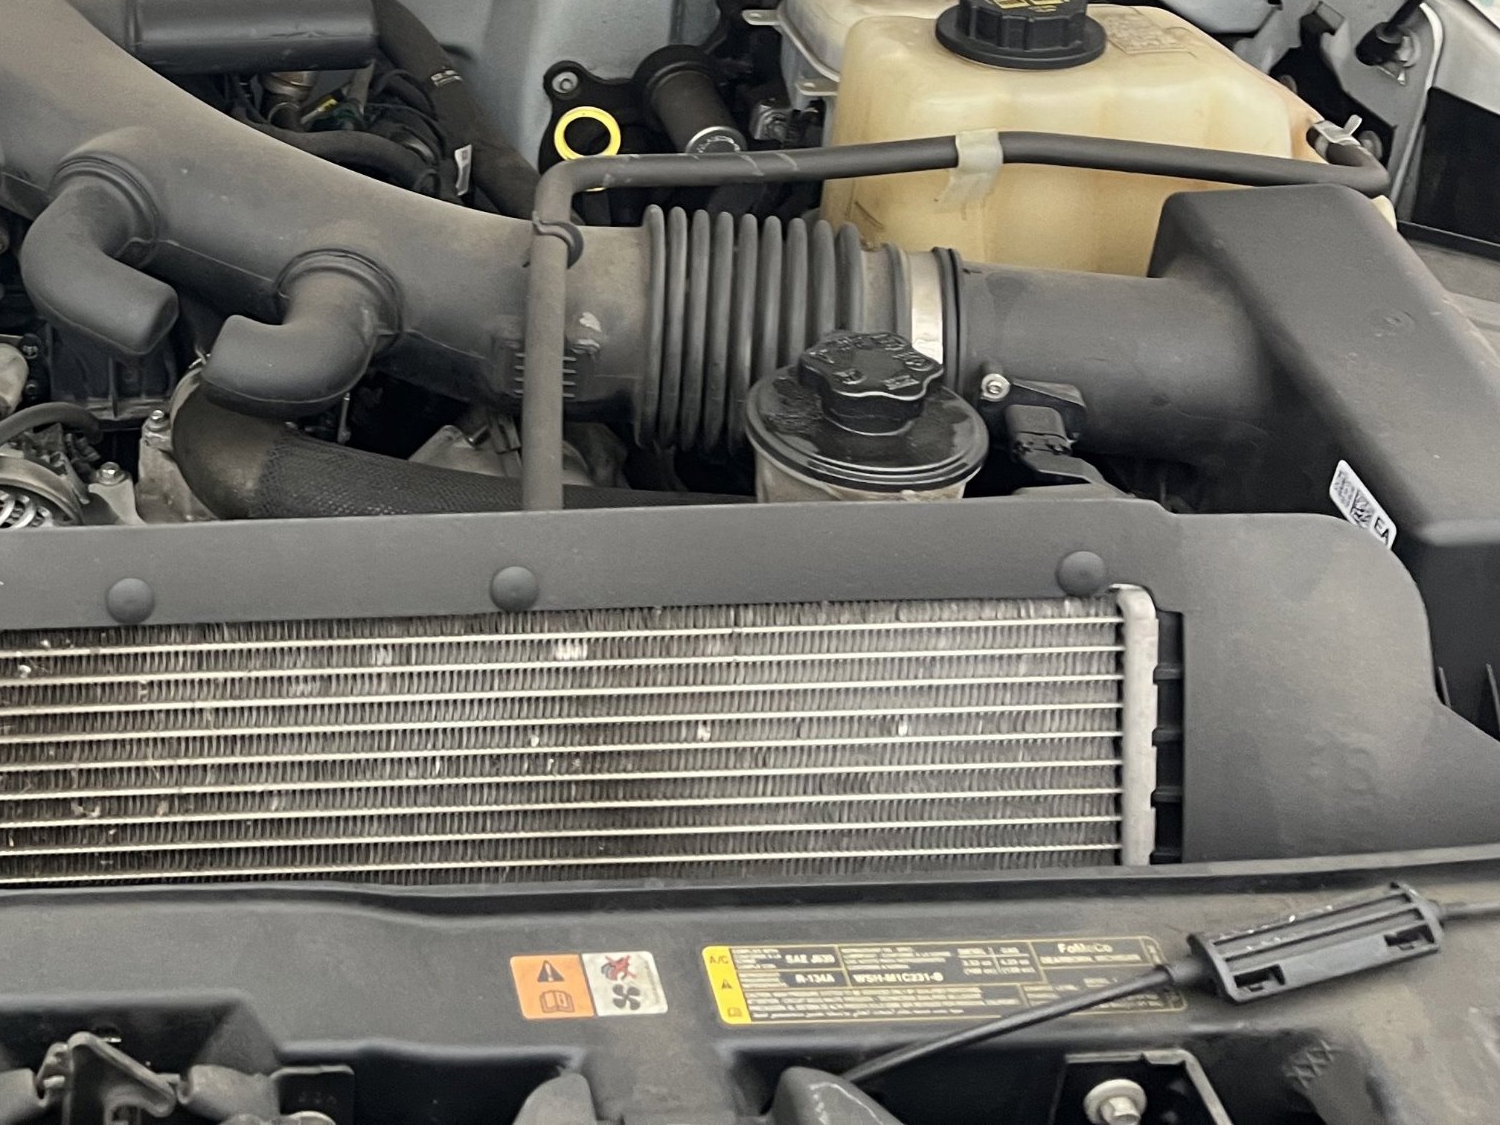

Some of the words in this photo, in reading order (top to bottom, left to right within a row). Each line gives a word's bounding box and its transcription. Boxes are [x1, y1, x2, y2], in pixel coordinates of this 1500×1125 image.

[1374, 516, 1389, 546] EA
[709, 955, 729, 964] A/C
[785, 954, 808, 964] SAE
[795, 973, 835, 984] R-134A
